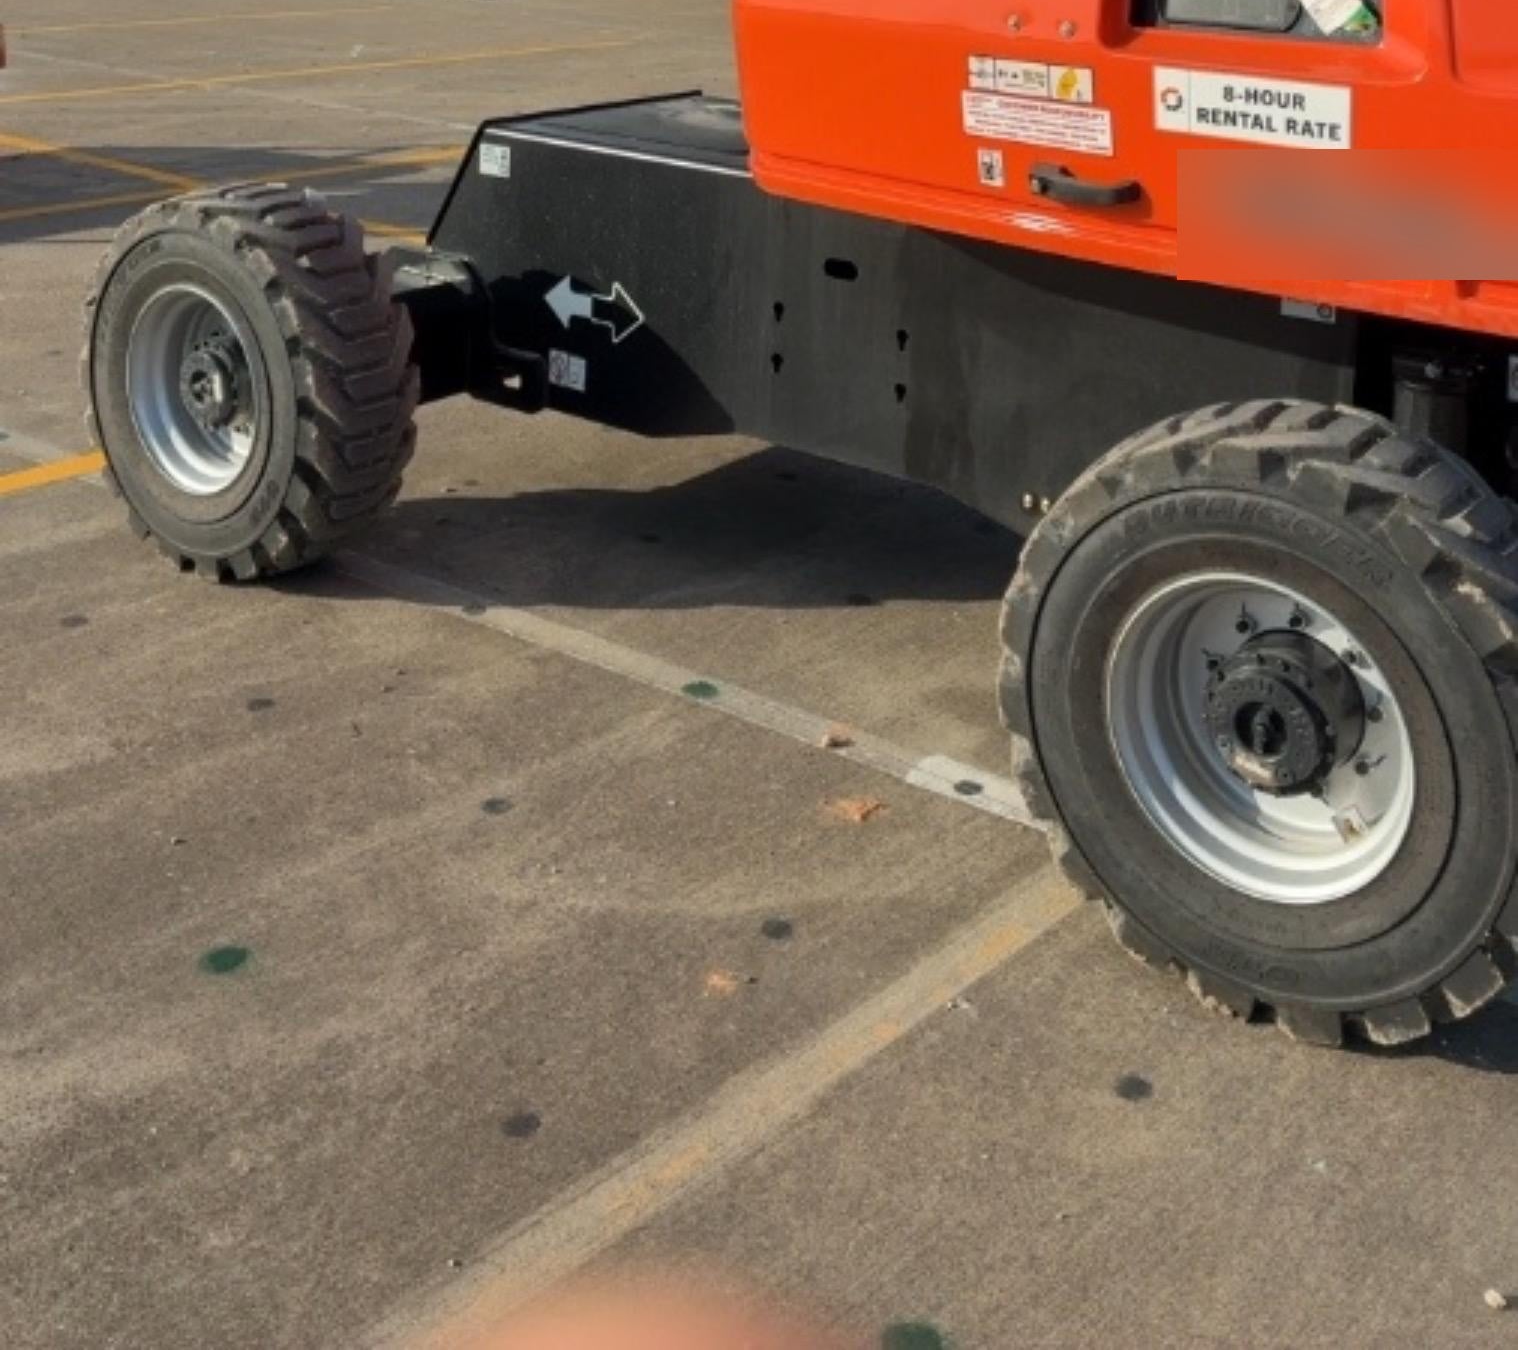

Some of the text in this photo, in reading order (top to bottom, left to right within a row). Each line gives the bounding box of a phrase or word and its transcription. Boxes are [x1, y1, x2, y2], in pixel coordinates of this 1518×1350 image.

[1223, 86, 1307, 111] 8-HOUR
[1196, 107, 1342, 142] RENTAL RATE
